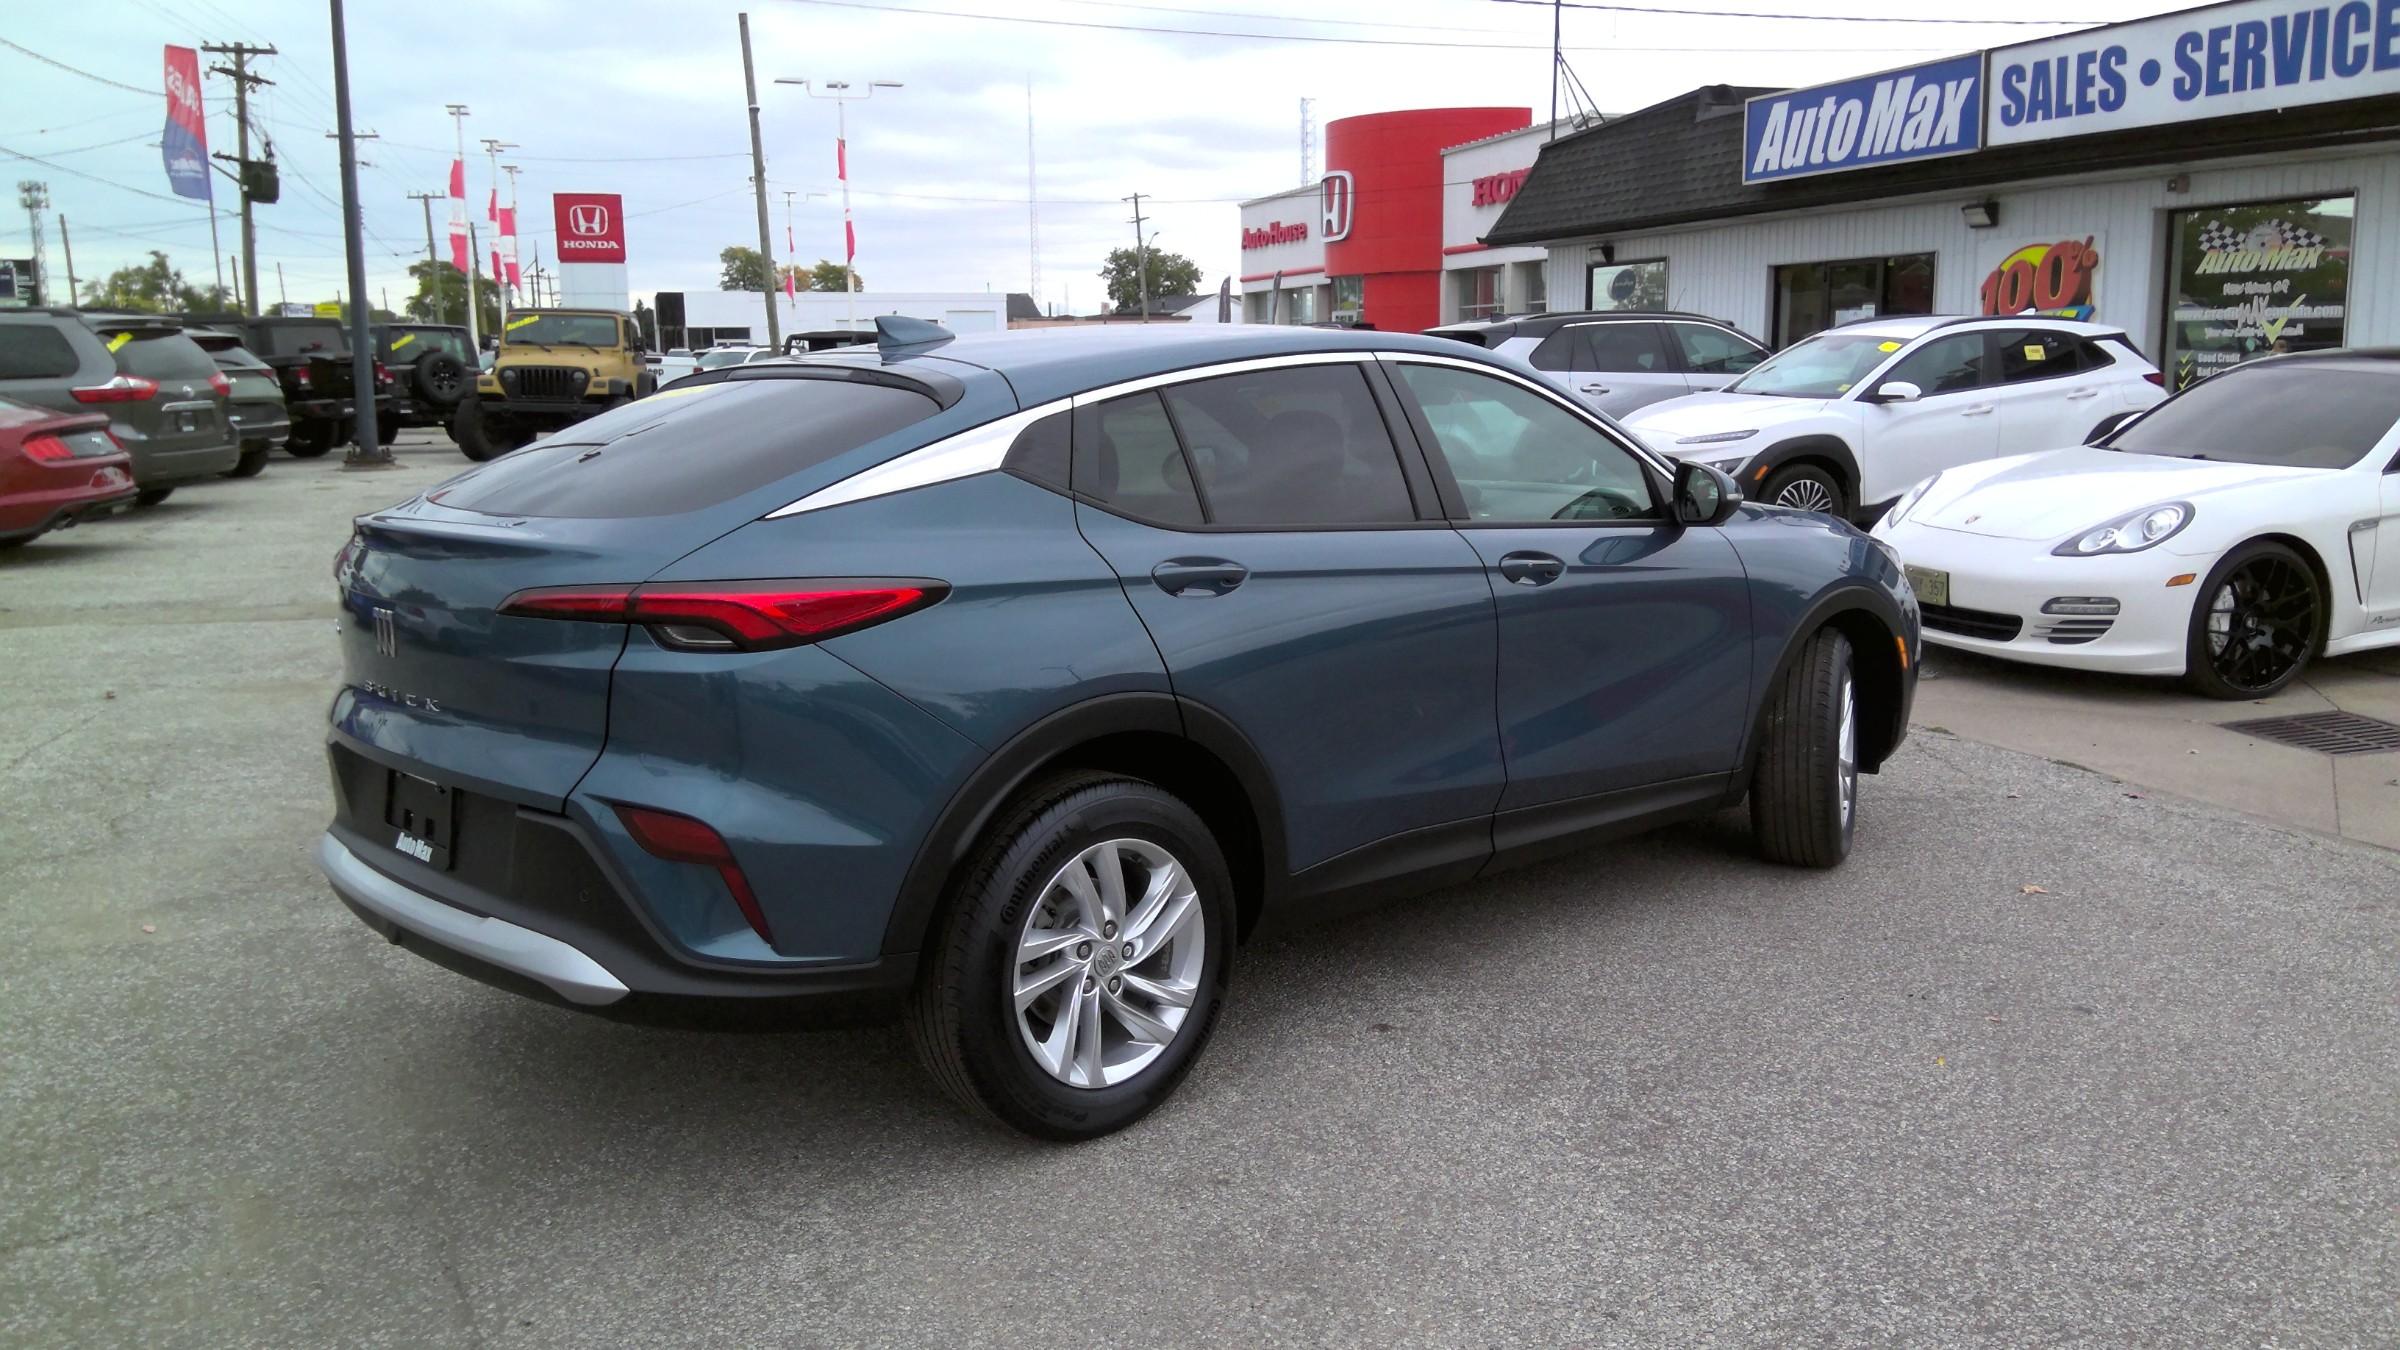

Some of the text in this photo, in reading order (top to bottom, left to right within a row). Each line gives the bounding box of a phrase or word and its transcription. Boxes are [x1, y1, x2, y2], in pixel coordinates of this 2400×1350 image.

[2000, 0, 2400, 127] SALES SERVICE
[562, 240, 620, 249] HONDA
[1981, 235, 2098, 316] 100%
[2198, 352, 2240, 363] Good Credit
